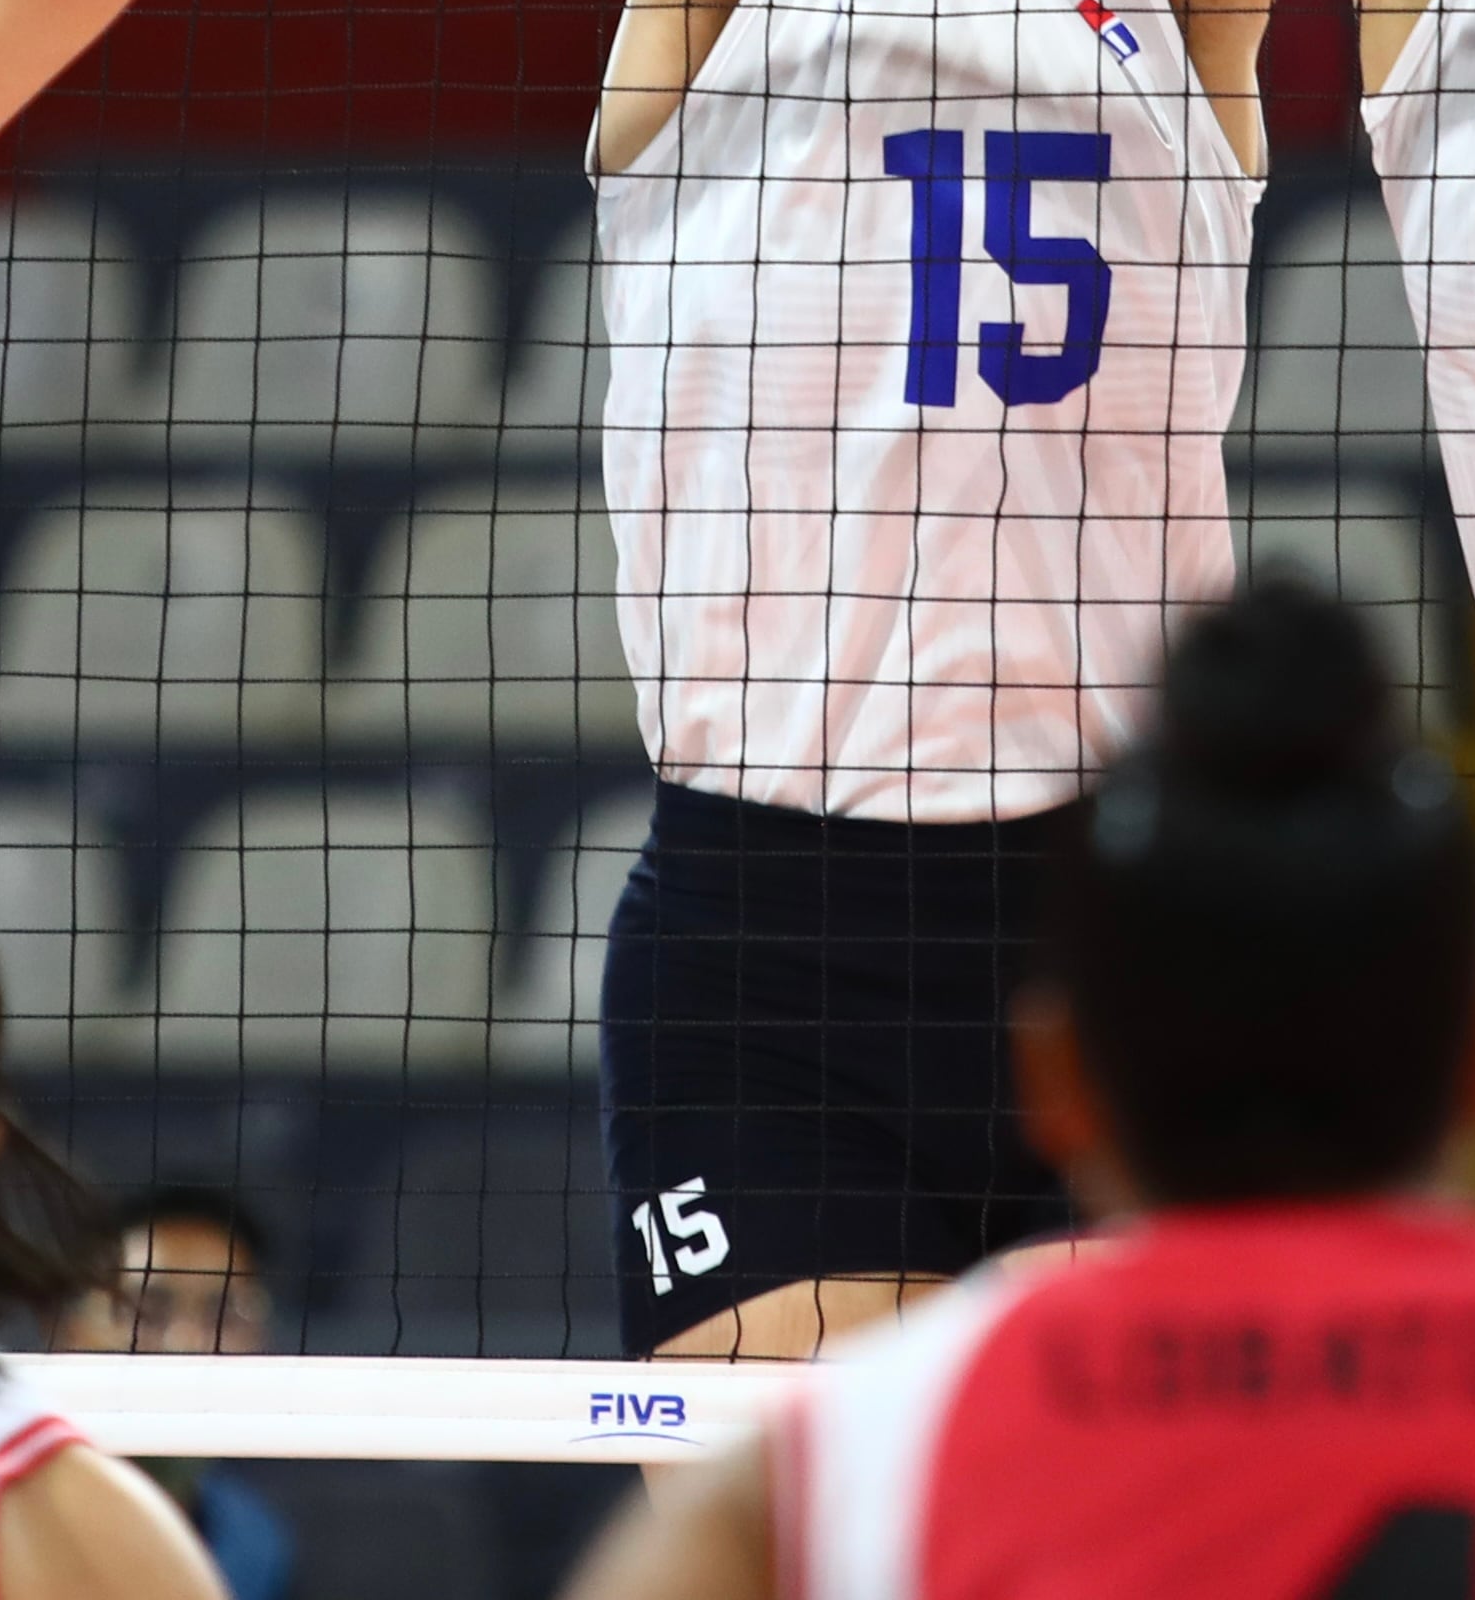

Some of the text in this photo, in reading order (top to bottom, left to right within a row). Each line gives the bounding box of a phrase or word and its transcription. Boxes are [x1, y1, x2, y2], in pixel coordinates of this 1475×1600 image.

[883, 130, 1112, 408] 15
[632, 1176, 730, 1297] 15
[589, 1393, 687, 1427] FIVB
